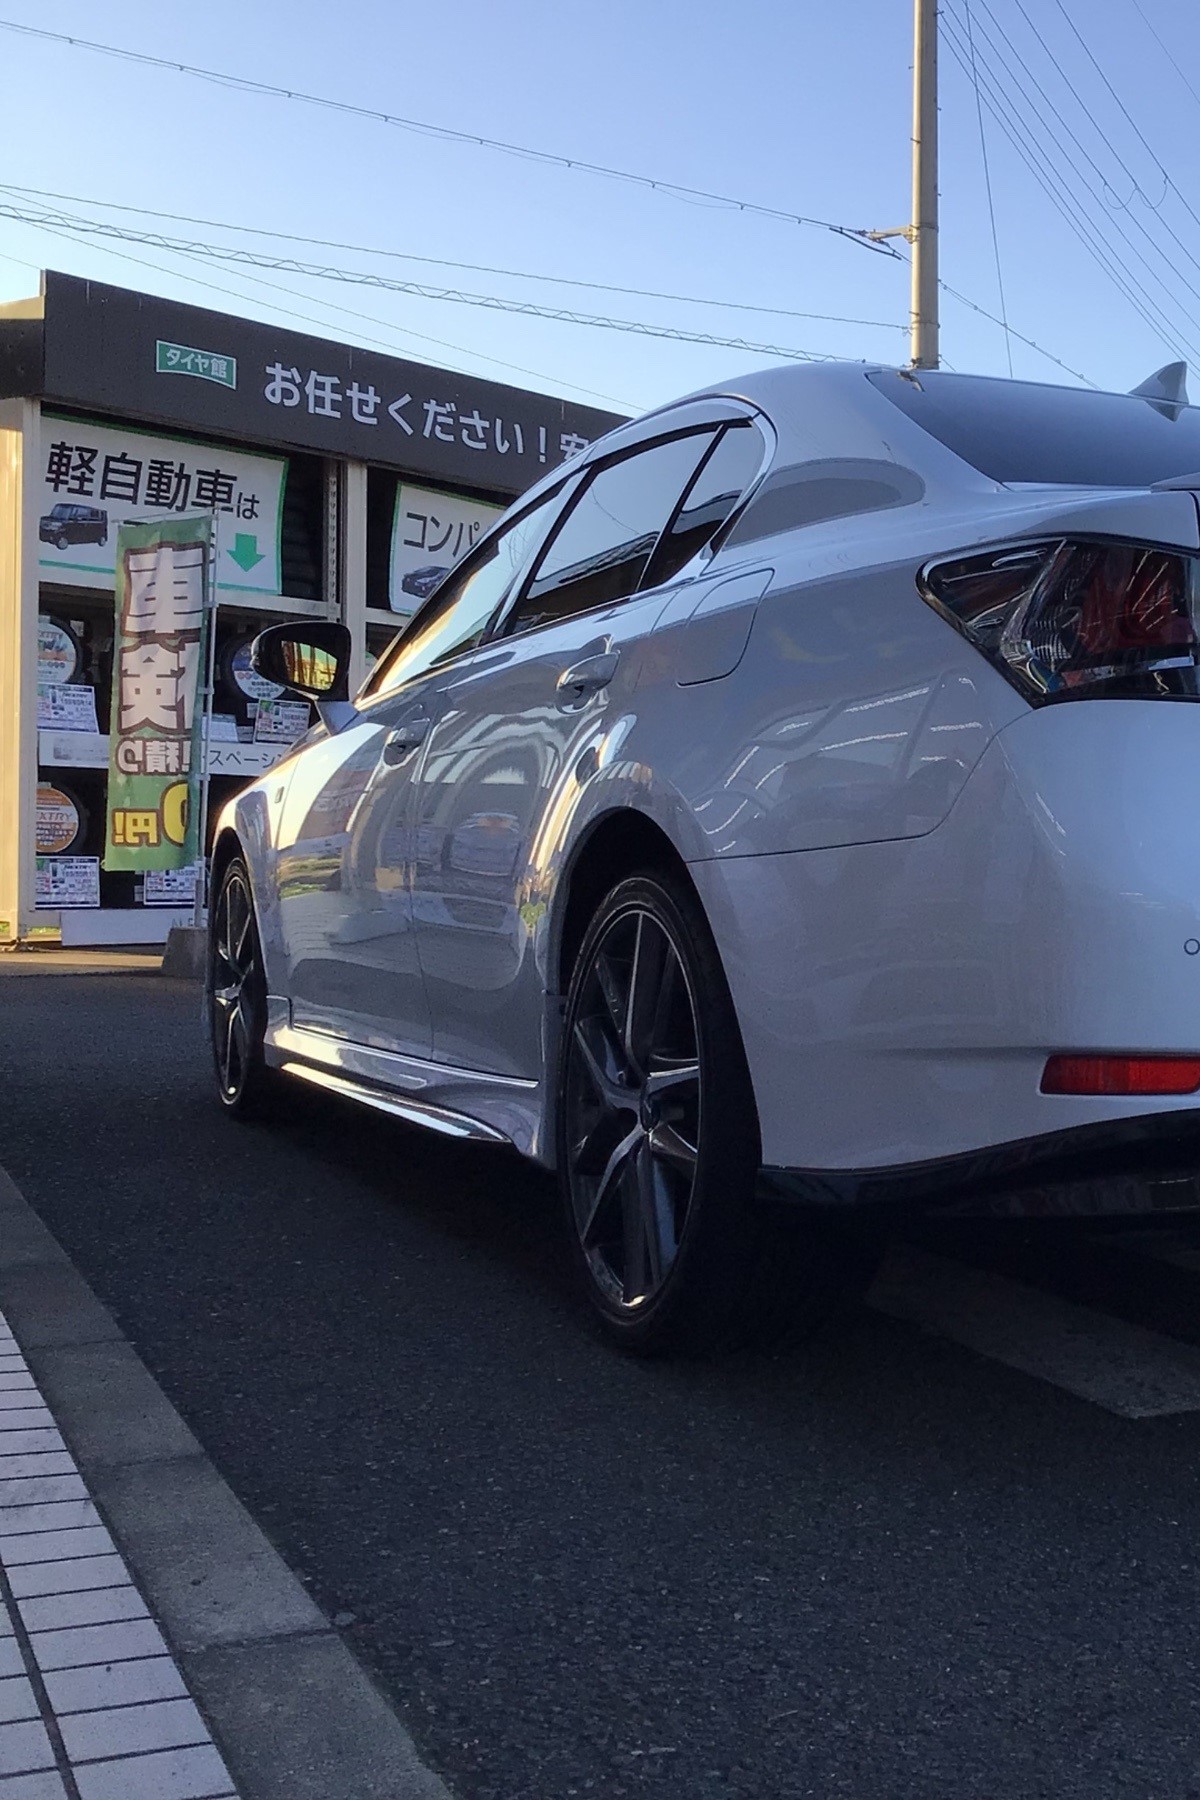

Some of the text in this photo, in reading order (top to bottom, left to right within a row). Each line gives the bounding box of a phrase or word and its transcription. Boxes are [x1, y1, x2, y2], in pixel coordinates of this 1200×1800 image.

[166, 346, 228, 378] タイヤ館
[45, 441, 260, 520] 軽自動車は
[404, 512, 480, 557] コンパ
[209, 750, 282, 768] スペーシ
